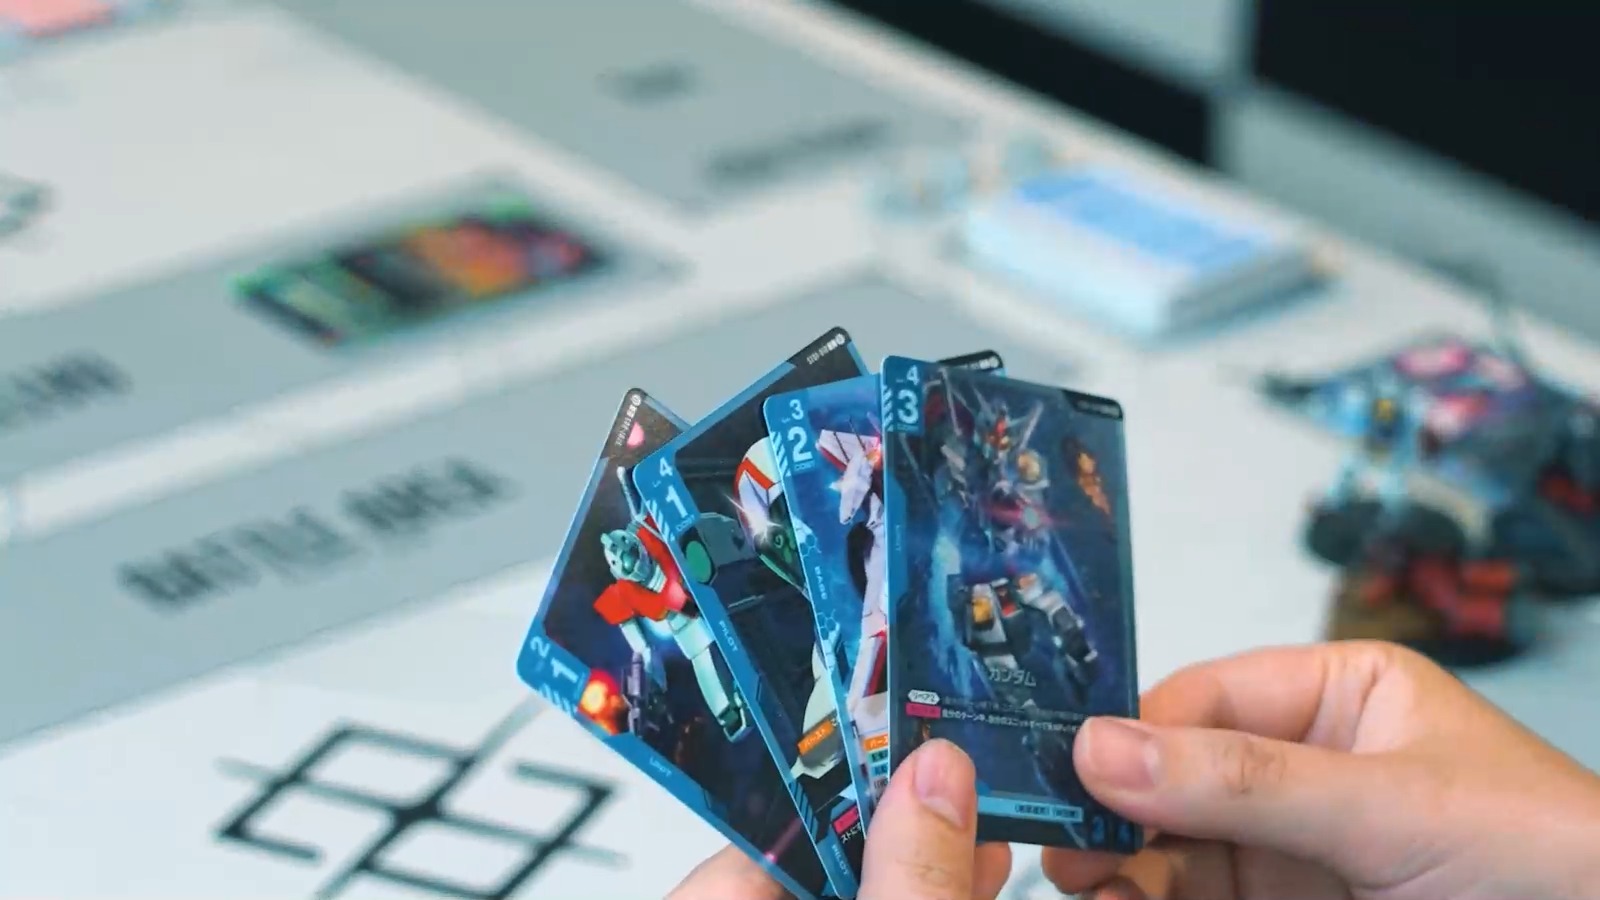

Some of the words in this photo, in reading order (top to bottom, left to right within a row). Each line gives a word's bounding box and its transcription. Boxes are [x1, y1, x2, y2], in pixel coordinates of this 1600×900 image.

[906, 365, 919, 385] 4
[789, 399, 804, 420] 3
[897, 388, 918, 424] 3
[787, 426, 813, 463] 2
[659, 457, 673, 478] 4
[665, 487, 688, 519] 1
[814, 566, 828, 600] BASE
[529, 636, 551, 658] 2
[718, 619, 738, 653] PILOT
[550, 657, 579, 683] 1
[988, 667, 1037, 687] ガンダム
[831, 843, 850, 877] PILOT
